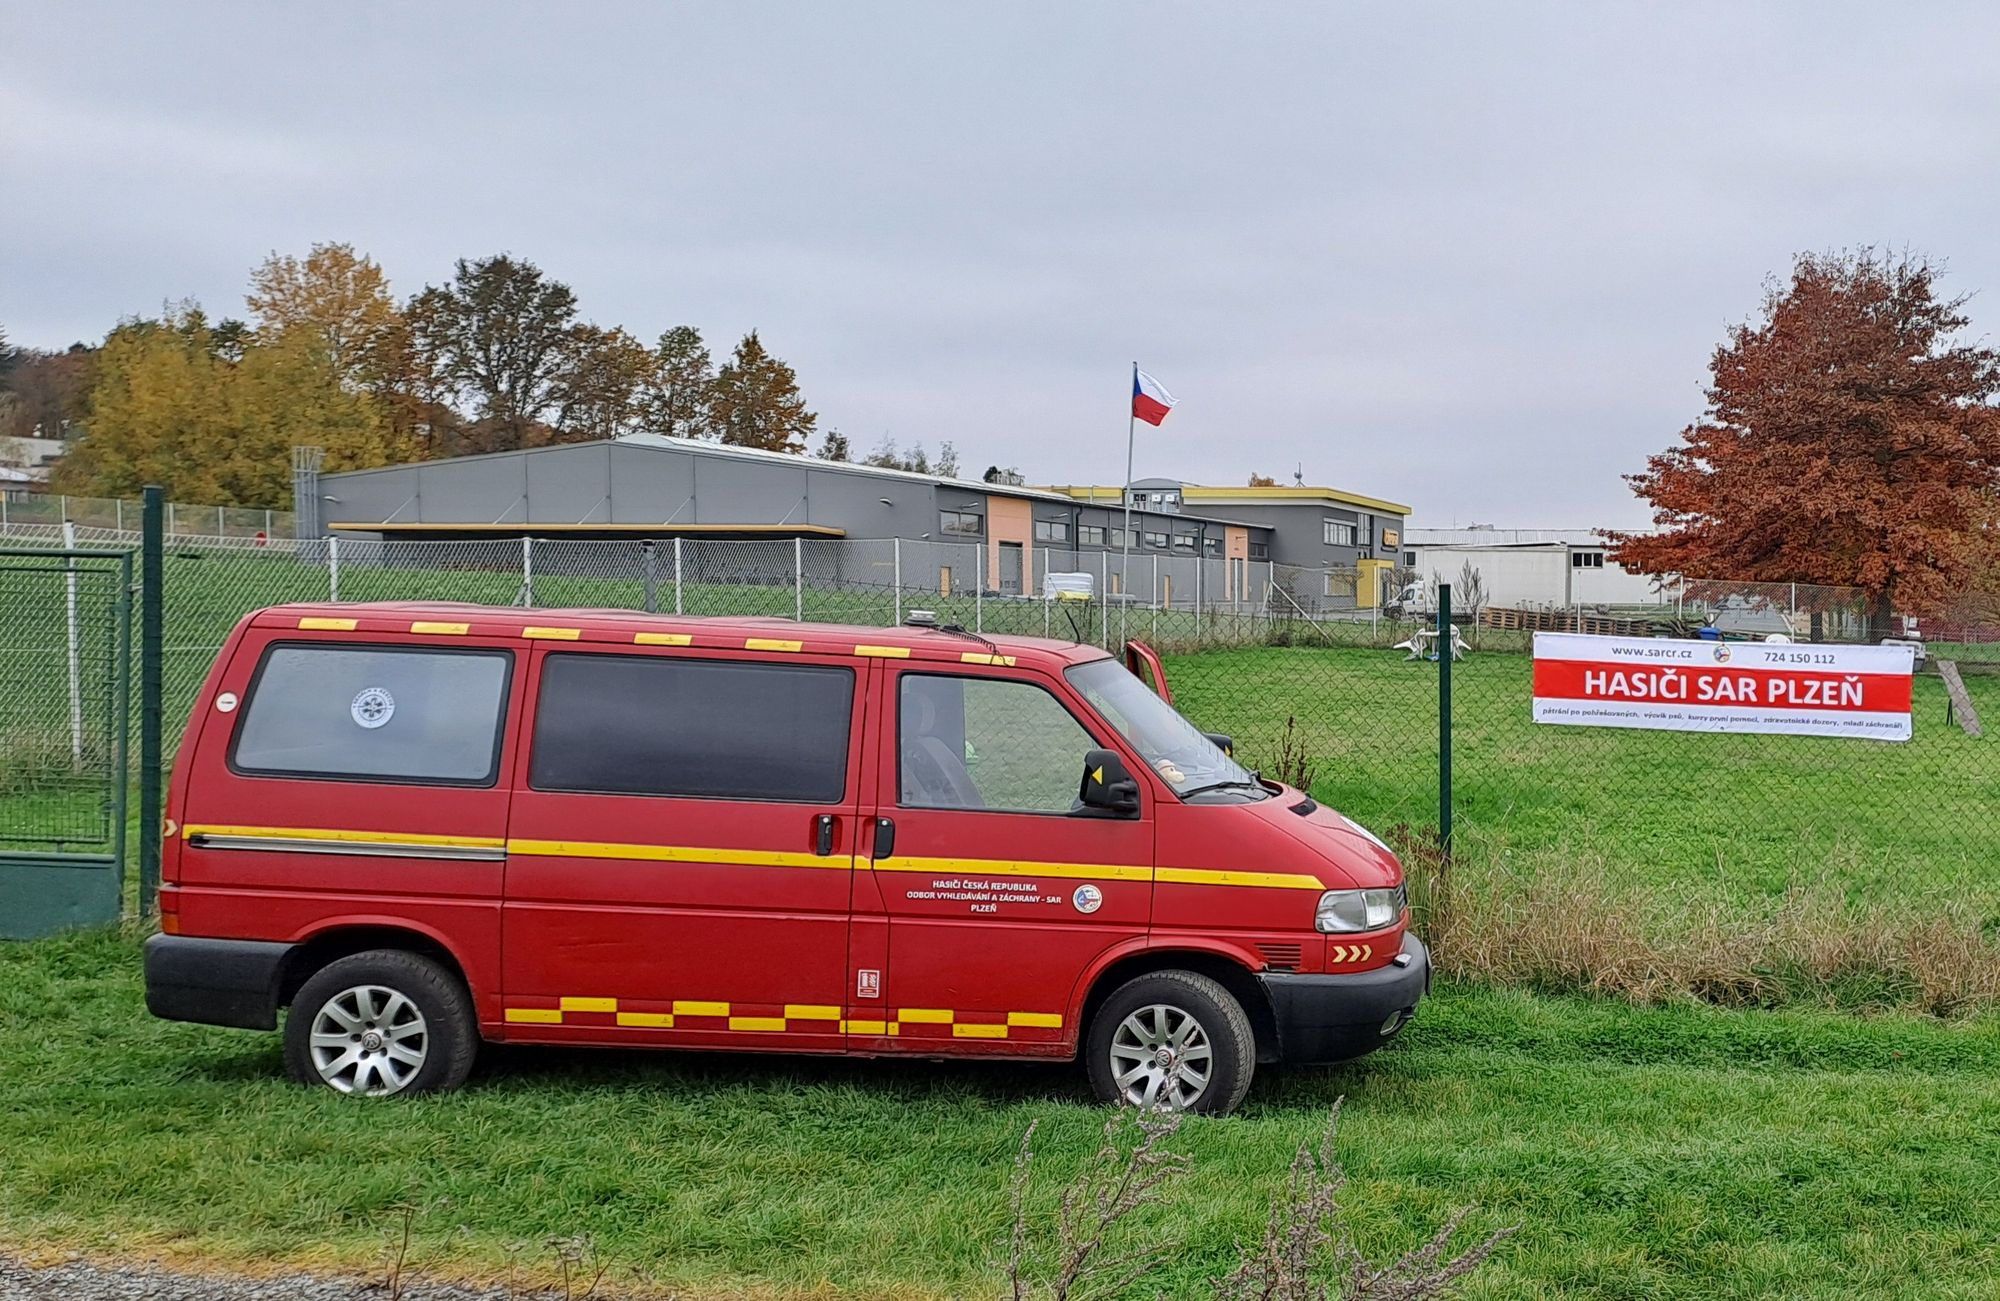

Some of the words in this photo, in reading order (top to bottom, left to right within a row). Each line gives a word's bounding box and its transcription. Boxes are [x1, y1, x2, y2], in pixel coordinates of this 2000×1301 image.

[1612, 646, 1692, 658] www.sarcr.cz
[1764, 652, 1786, 662] 724
[1790, 654, 1810, 664] 150
[1814, 654, 1836, 664] 112
[1585, 668, 1688, 699] HASIČI
[1697, 676, 1758, 702] SAR
[1768, 676, 1864, 706] PLZEŇ
[932, 879, 960, 889] HASIČI
[962, 880, 989, 890] ČESKÁ
[991, 882, 1037, 892] REPUBLIKA
[906, 891, 936, 899] ODBOR
[937, 891, 990, 901] VYHLEDÁVÁNÍ
[999, 894, 1040, 903] ZÁCHRANY
[971, 904, 996, 912] PLZEŇ
